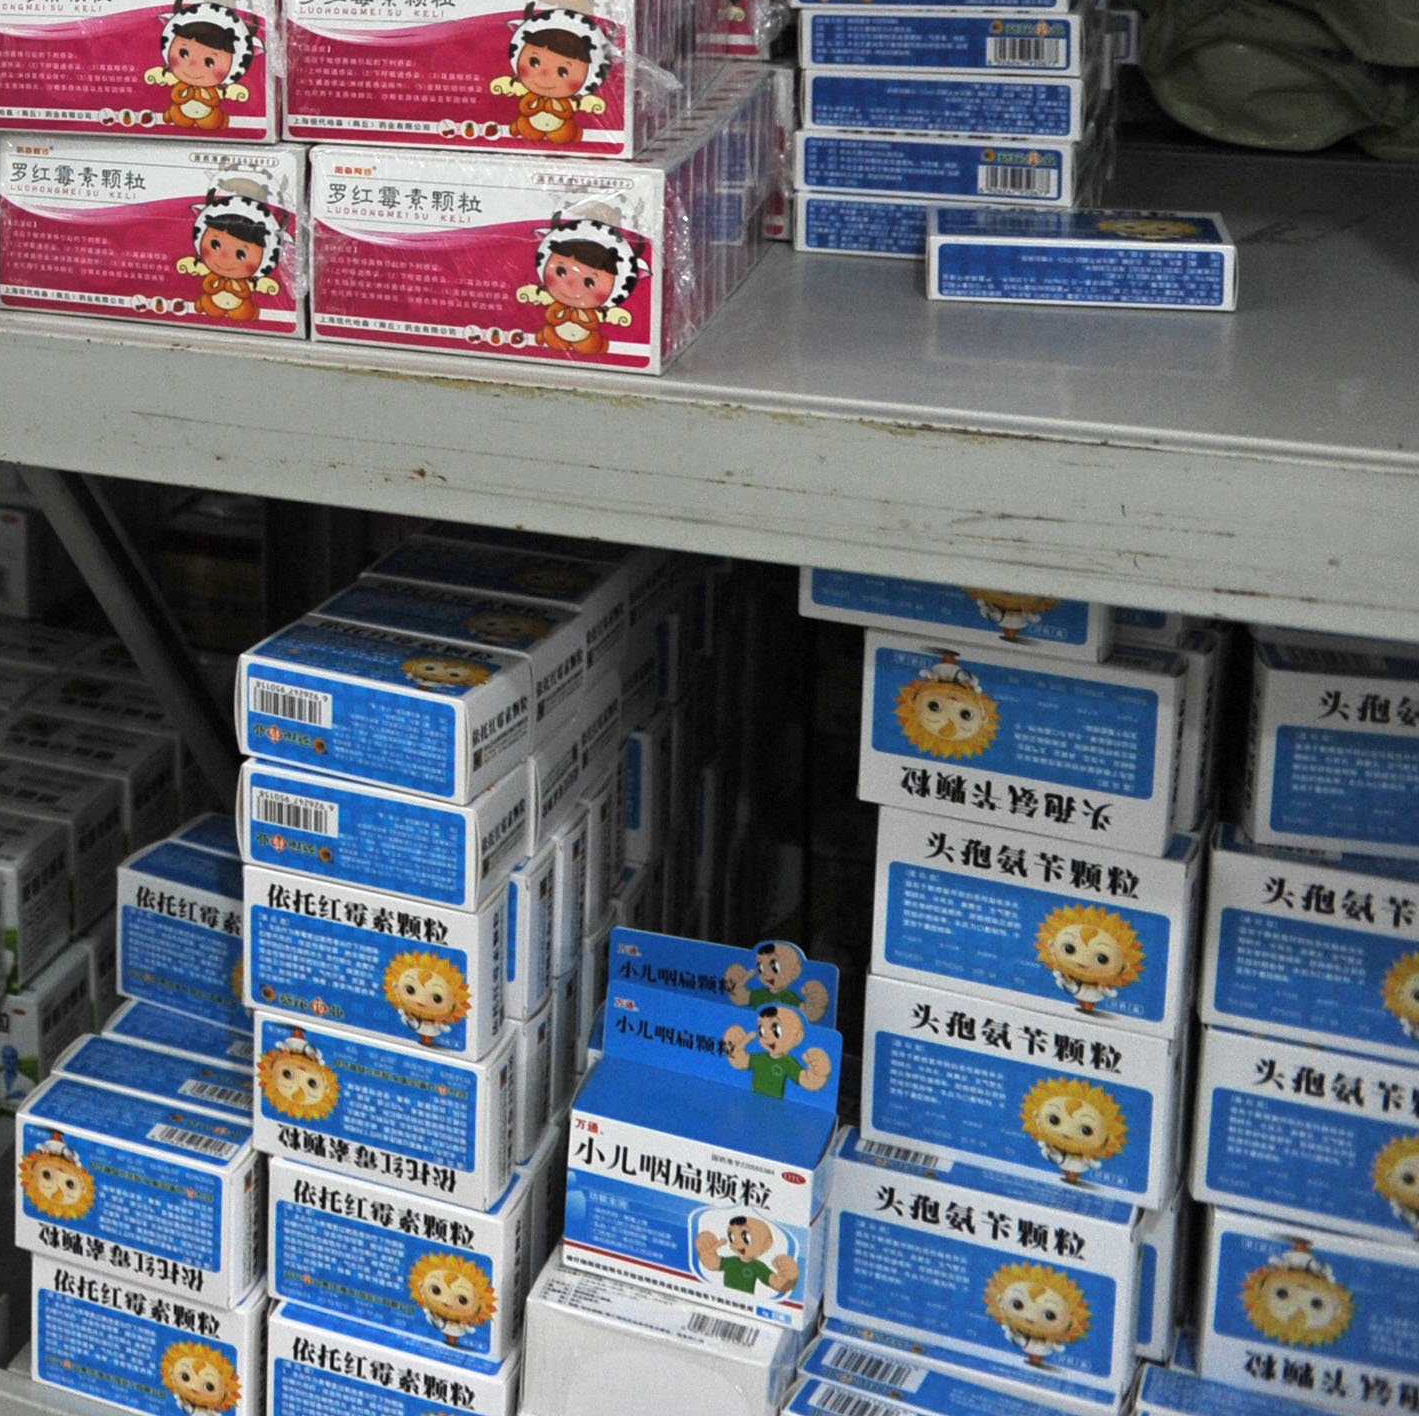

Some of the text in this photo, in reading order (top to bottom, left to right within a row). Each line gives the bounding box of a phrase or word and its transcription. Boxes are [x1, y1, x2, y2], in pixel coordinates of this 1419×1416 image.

[75, 4, 102, 13] KELI
[414, 8, 445, 18] KELI
[10, 162, 146, 191] 罗红霉素颗粒
[109, 191, 137, 200] KELI
[327, 184, 483, 214] 罗红霉素颗粒
[440, 214, 472, 223] KELI
[901, 766, 1114, 832] 头孢氨苄颗粒
[925, 832, 1140, 900] 头孢氨苄颗粒
[135, 885, 243, 935] 依托红霉素
[267, 883, 449, 946] 依托红霉素颗粒
[615, 1016, 736, 1059] 小儿咽扁颗粒
[911, 1003, 1122, 1074] 头孢氨苄颗粒
[1253, 1058, 1419, 1119] 头孢氨苄
[575, 1118, 599, 1134] 万通
[277, 1123, 457, 1193] 依托红霉素颗粒
[574, 1136, 773, 1211] 小儿咽扁颗粒
[293, 1179, 475, 1250] 依托红霉素颗粒
[874, 1184, 1087, 1261] 头孢氨苄颗粒
[38, 1222, 204, 1292] 依托红霉素颗粒
[54, 1268, 221, 1339] 依托红霉素颗粒
[292, 1336, 476, 1410] 依托红霉素颗粒
